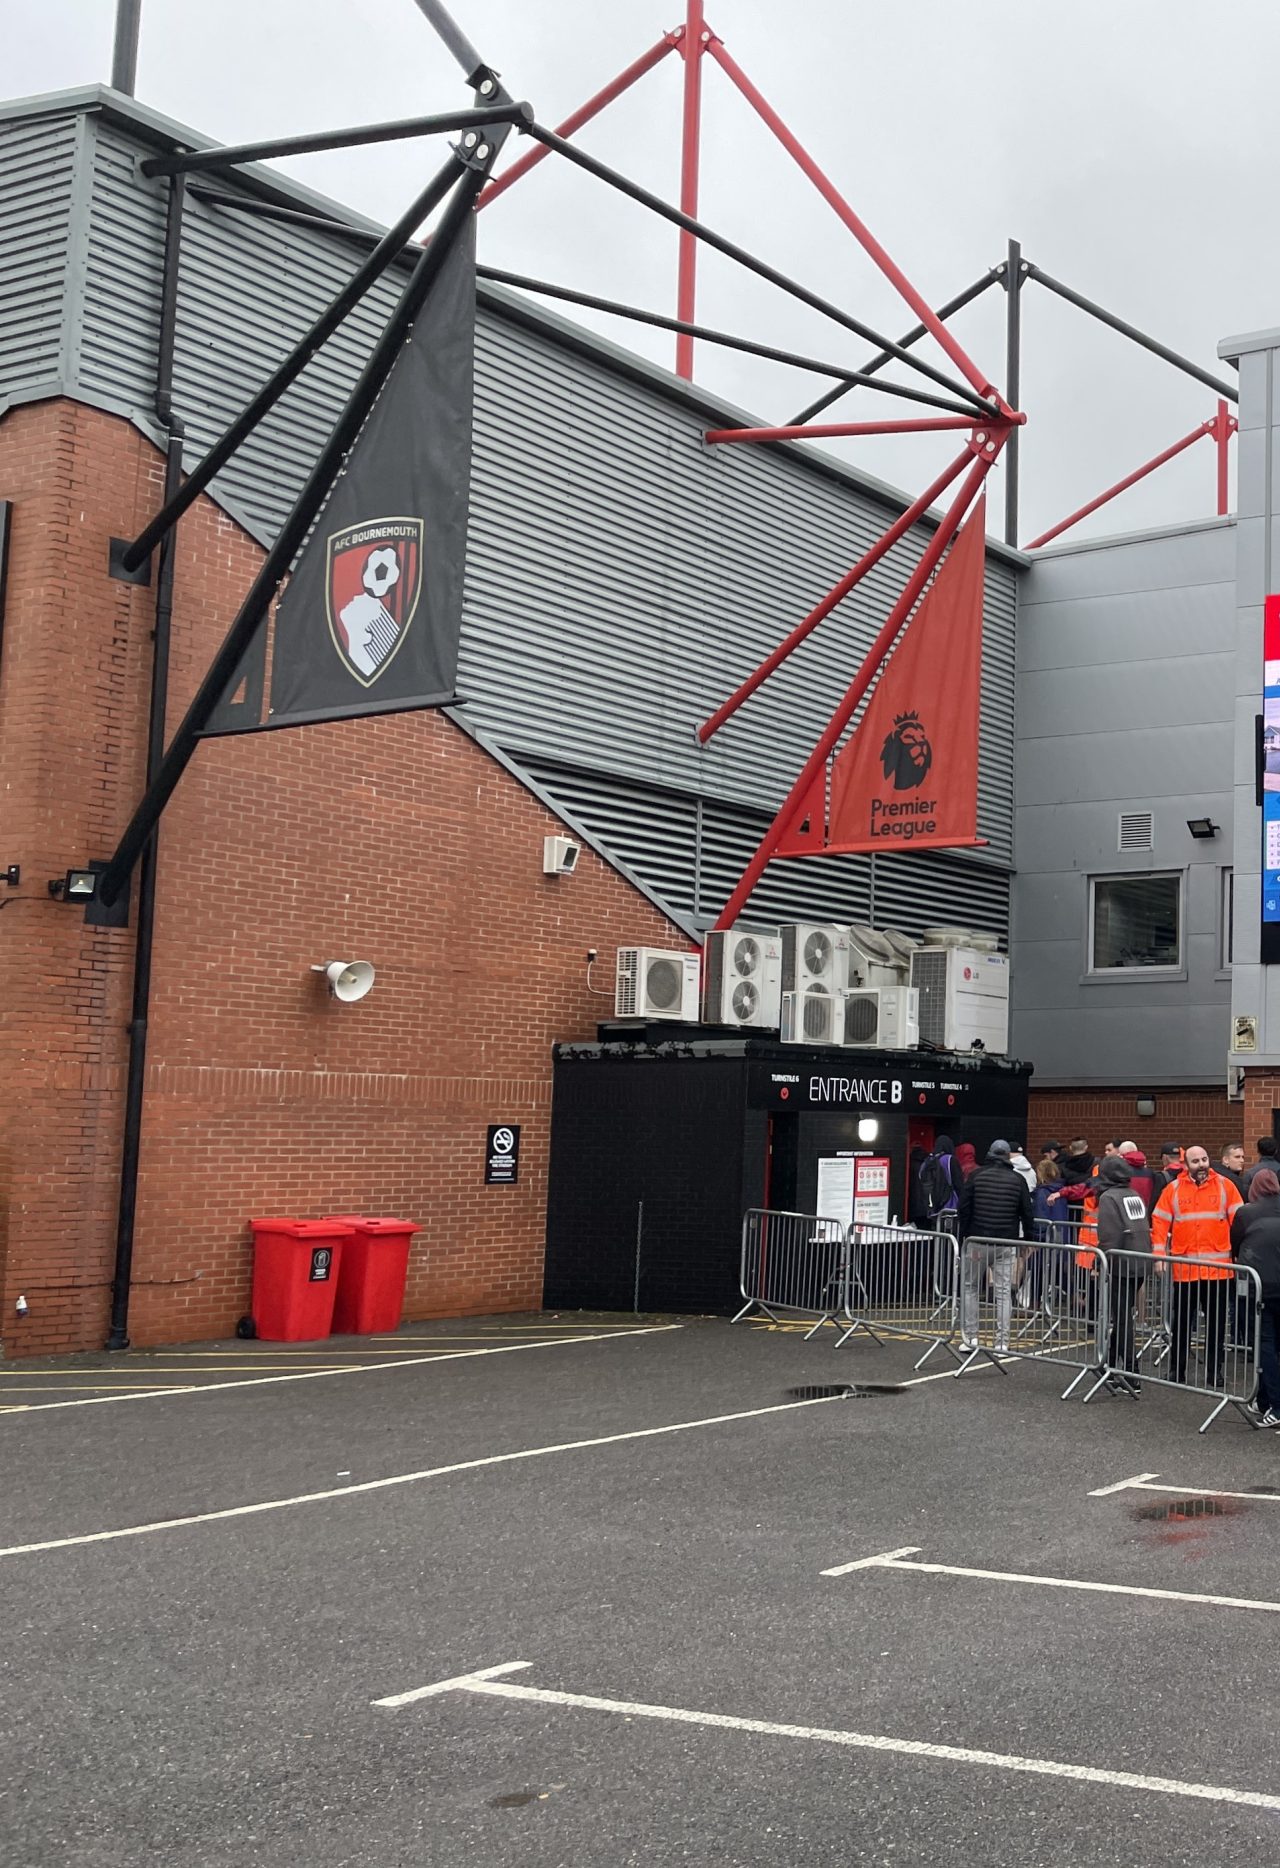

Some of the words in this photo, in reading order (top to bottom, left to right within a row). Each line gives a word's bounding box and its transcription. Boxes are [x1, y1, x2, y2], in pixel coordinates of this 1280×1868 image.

[334, 537, 351, 551] AFC
[351, 526, 418, 544] BOURNEMOUTH
[871, 796, 937, 817] Premier
[870, 819, 937, 840] League
[771, 1074, 795, 1083] TURNSTILE
[809, 1076, 888, 1103] ENTRANCE
[891, 1080, 903, 1104] B
